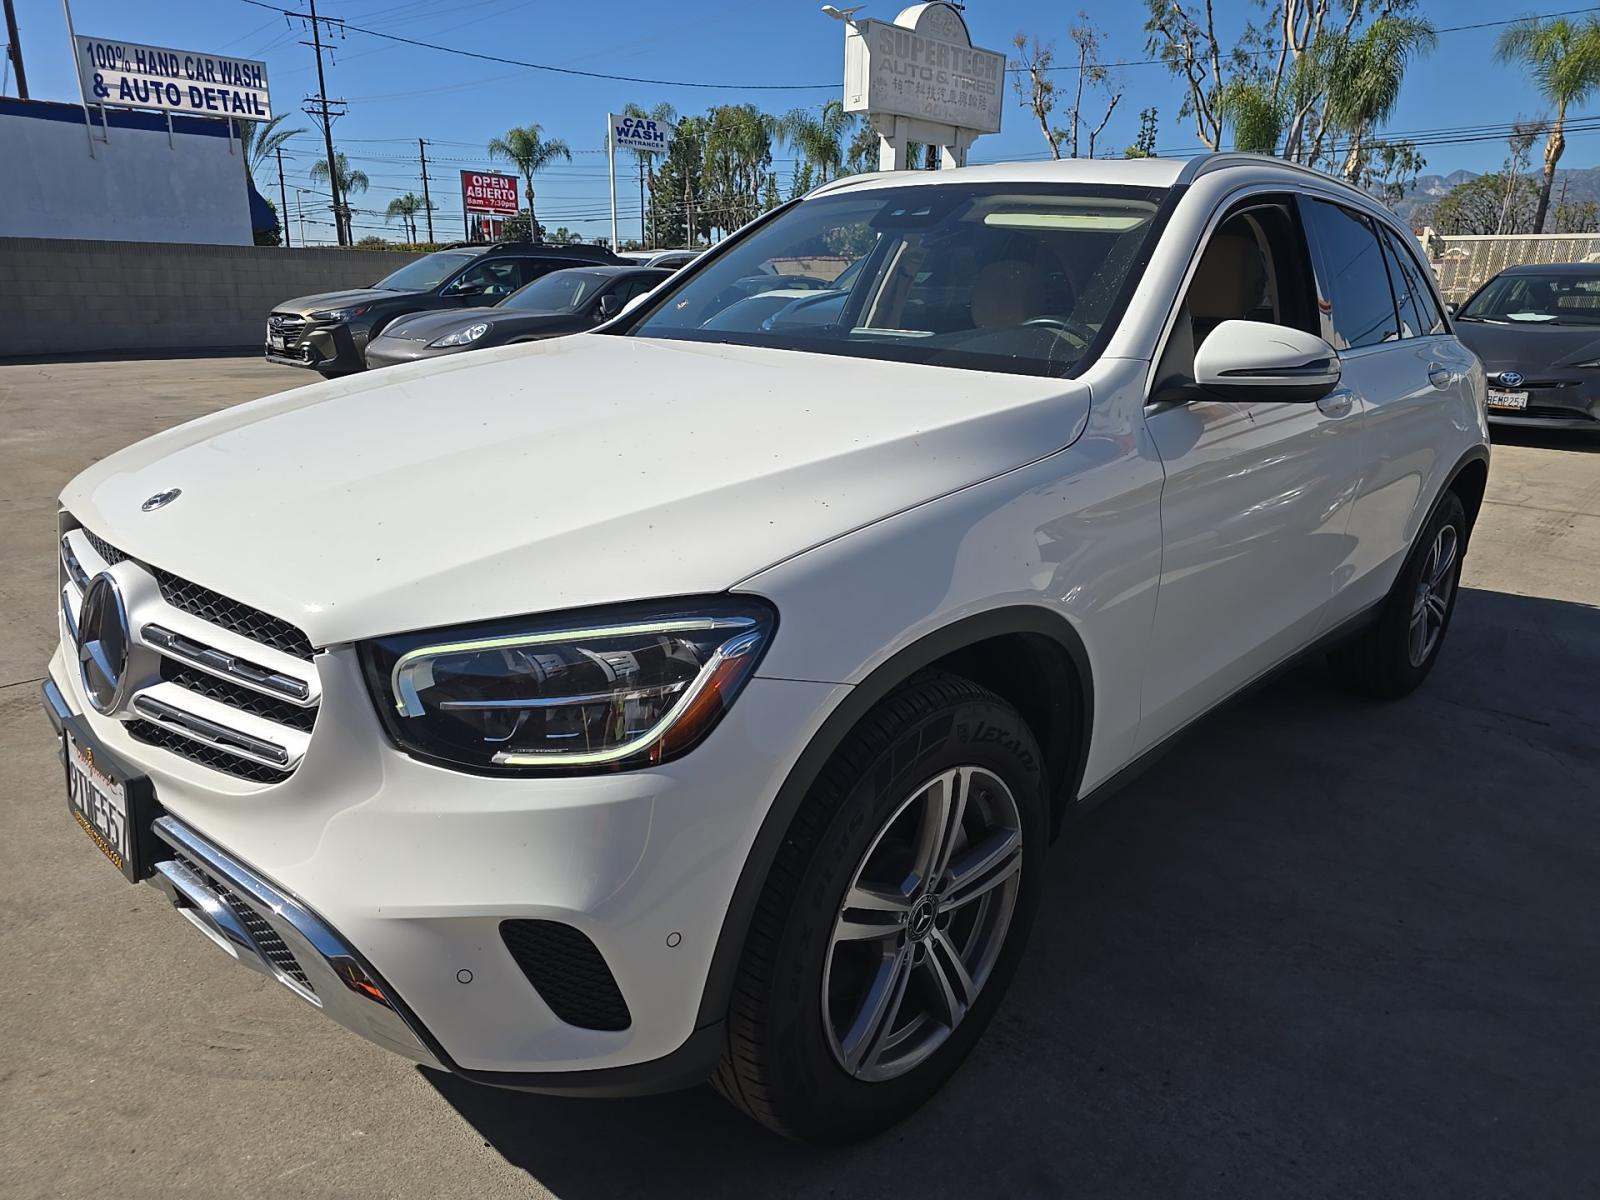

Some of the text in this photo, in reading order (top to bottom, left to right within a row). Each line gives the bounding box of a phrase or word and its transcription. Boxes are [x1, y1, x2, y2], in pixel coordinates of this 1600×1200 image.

[87, 42, 263, 88] 100% HAND CAR WASH
[879, 58, 933, 80] AUTO
[93, 73, 266, 116] & AUTO DETAIL
[623, 117, 657, 131] CAR
[616, 126, 664, 142] WASH
[624, 138, 660, 148] ENTRANCE
[472, 175, 509, 189] OPEN
[467, 186, 516, 201] ABIERTO
